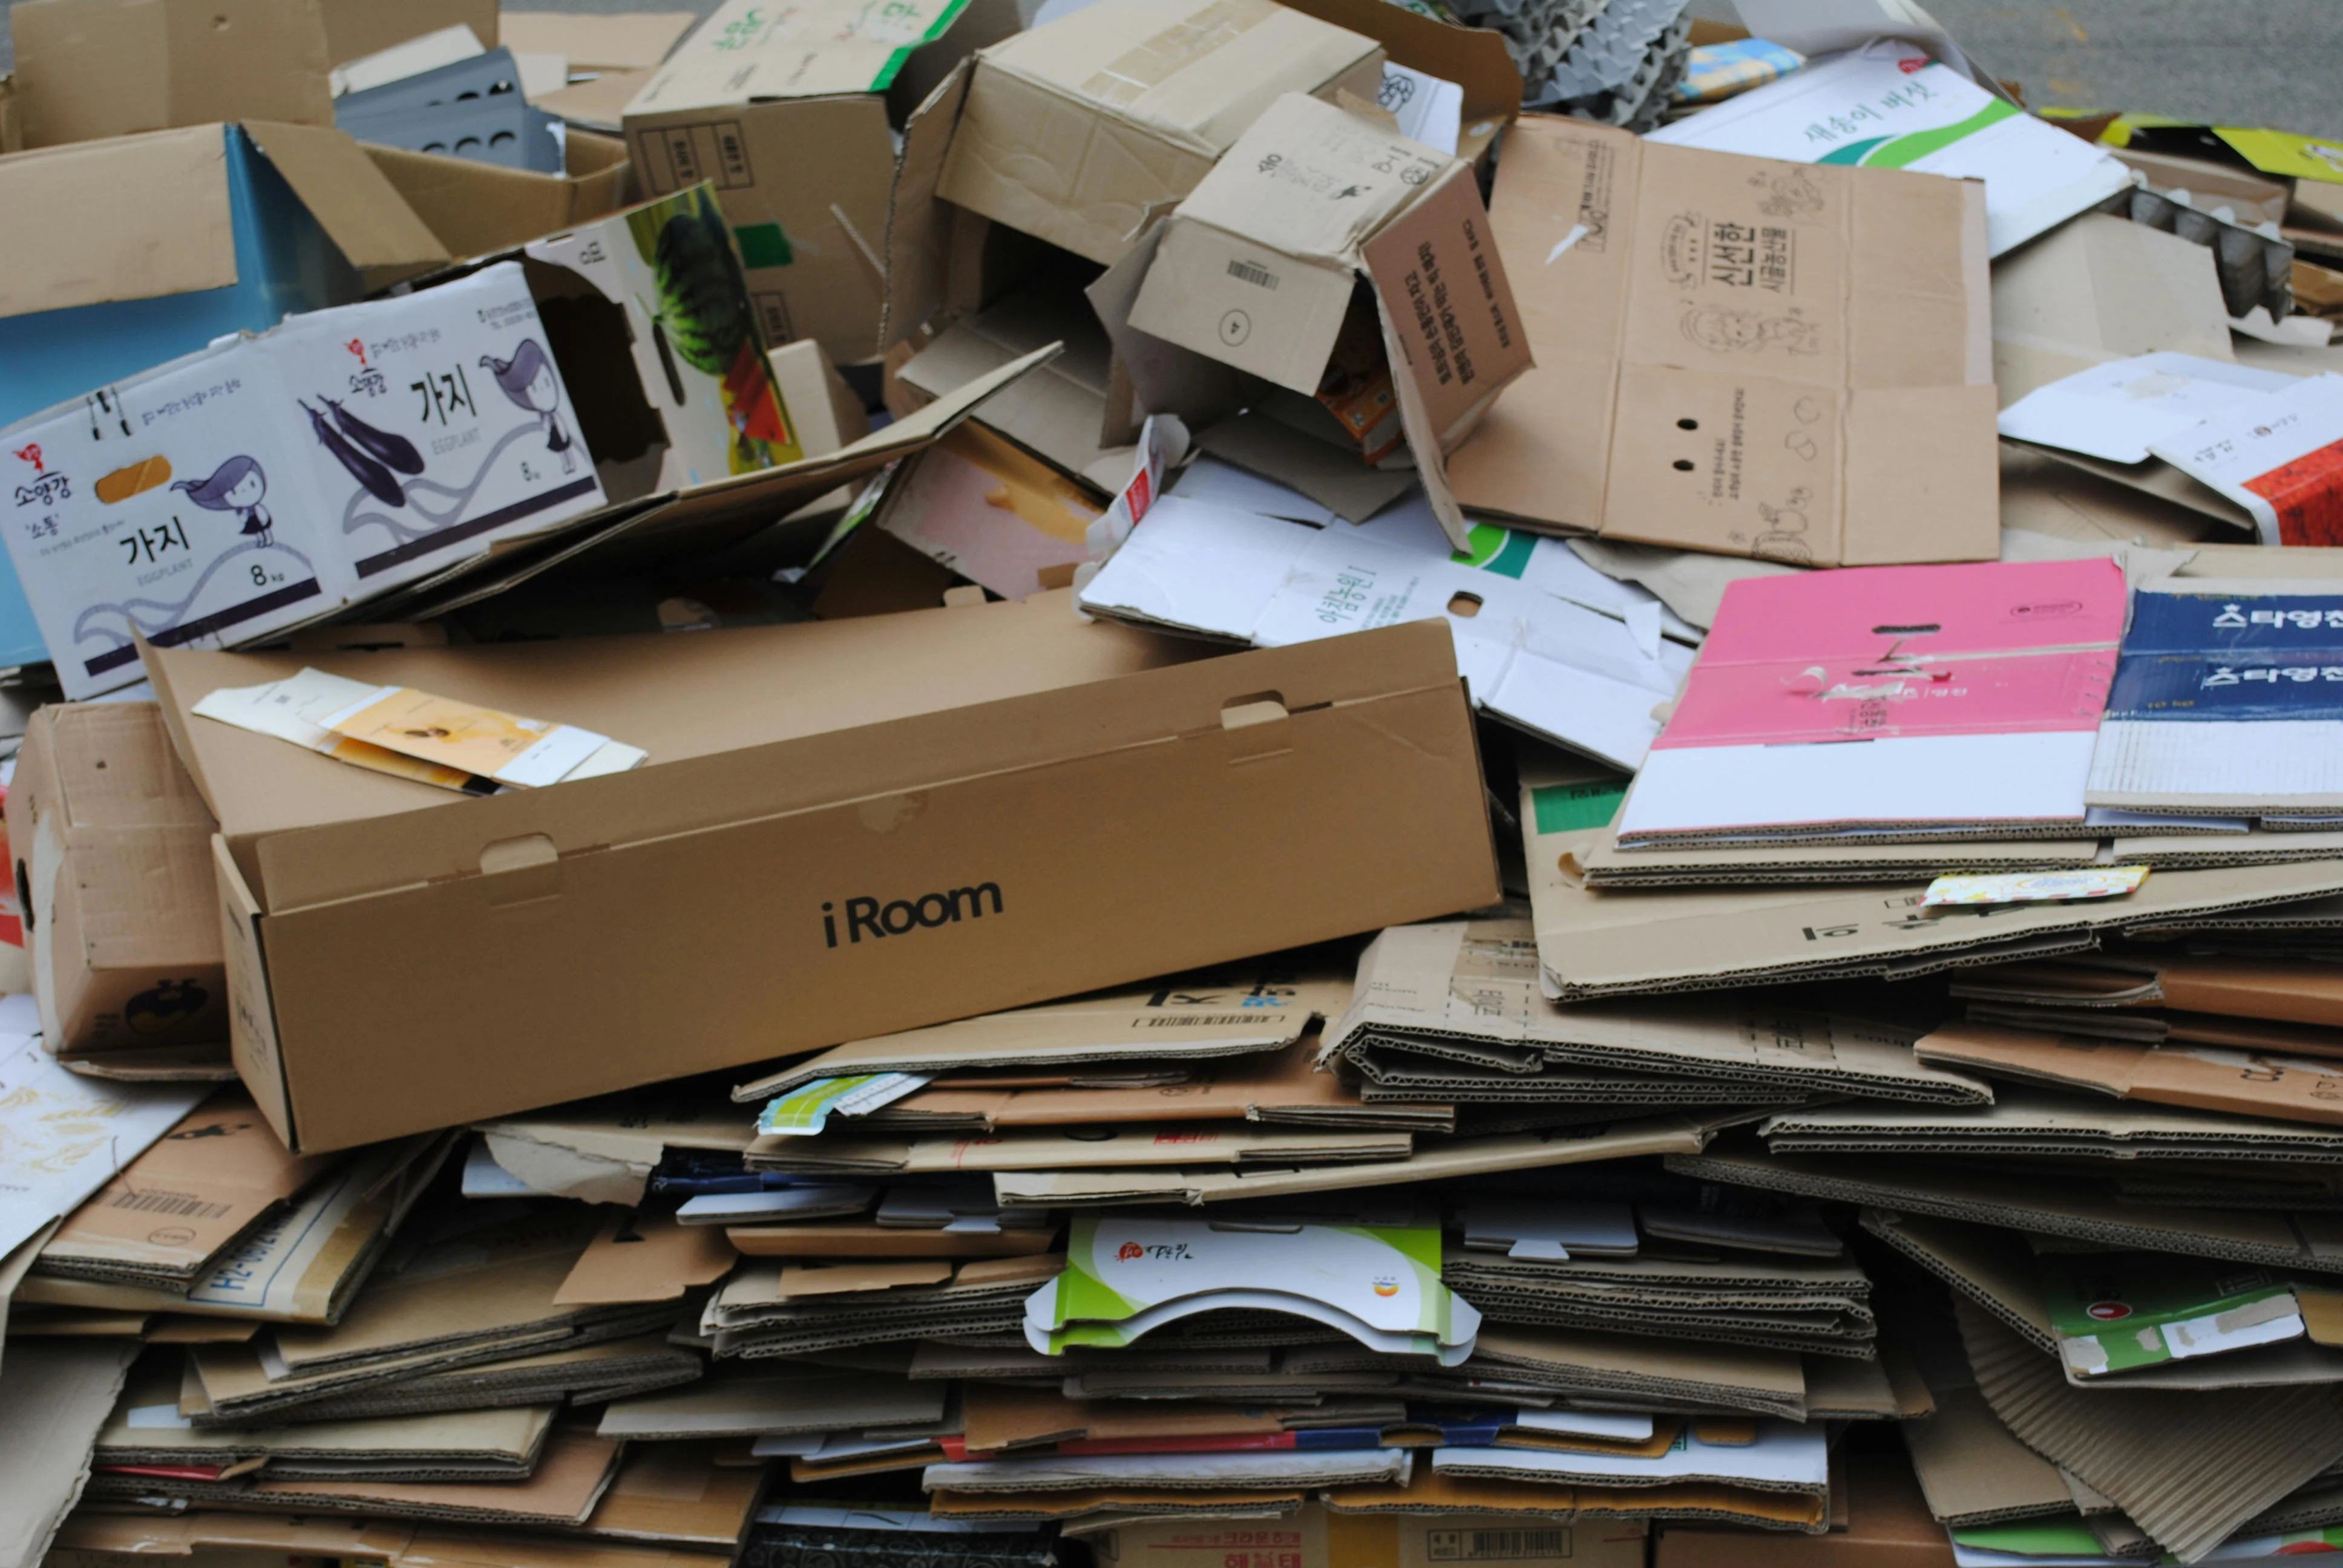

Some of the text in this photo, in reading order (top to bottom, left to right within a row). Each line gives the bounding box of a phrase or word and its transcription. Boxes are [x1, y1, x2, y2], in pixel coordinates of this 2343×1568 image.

[1711, 222, 1754, 287] 신선한
[411, 364, 477, 426] 가지
[431, 429, 482, 457] EGGPLANT
[15, 474, 72, 508] 소양강
[120, 516, 190, 566] 가지
[136, 559, 194, 588] EGGPLANT
[1316, 572, 1374, 624] 아침농원
